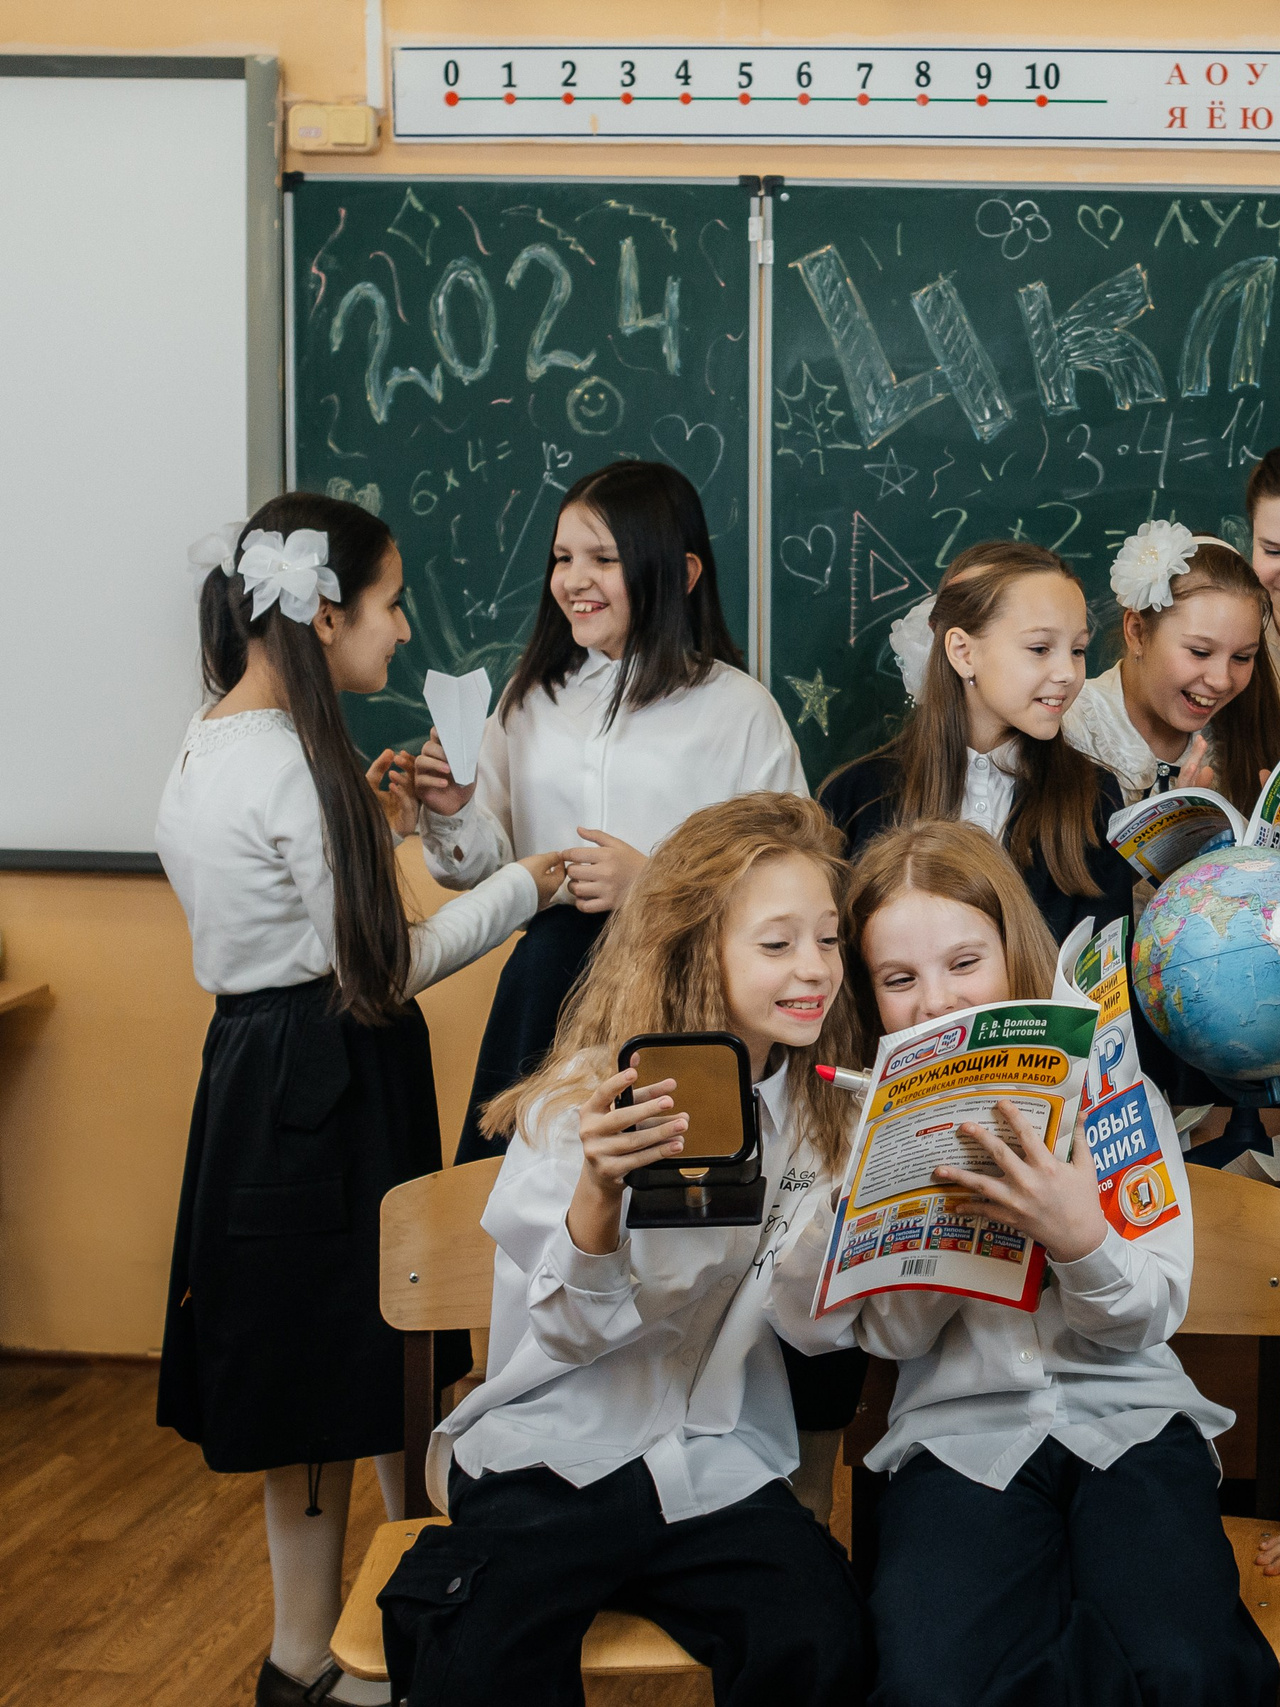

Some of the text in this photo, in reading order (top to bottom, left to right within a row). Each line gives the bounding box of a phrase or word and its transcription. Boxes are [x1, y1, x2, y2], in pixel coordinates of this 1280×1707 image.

[445, 60, 1060, 90] 0 1 2 3 4 5 6 7 8 9 10
[330, 235, 681, 424] 2024
[1103, 991, 1121, 1012] МИР
[1001, 1028, 1047, 1039] Цитович
[1003, 1018, 1048, 1028] Волкова
[888, 1050, 1061, 1099] ОКРУЖАЮЩИЙ МИР
[895, 1072, 1057, 1107] ВСЕРОССИЙСКАЯ ПРОВЕРОЧНАЯ РАБОТА
[1086, 1100, 1142, 1148] ОВЫЕ
[1093, 1129, 1147, 1173] АНИЯ
